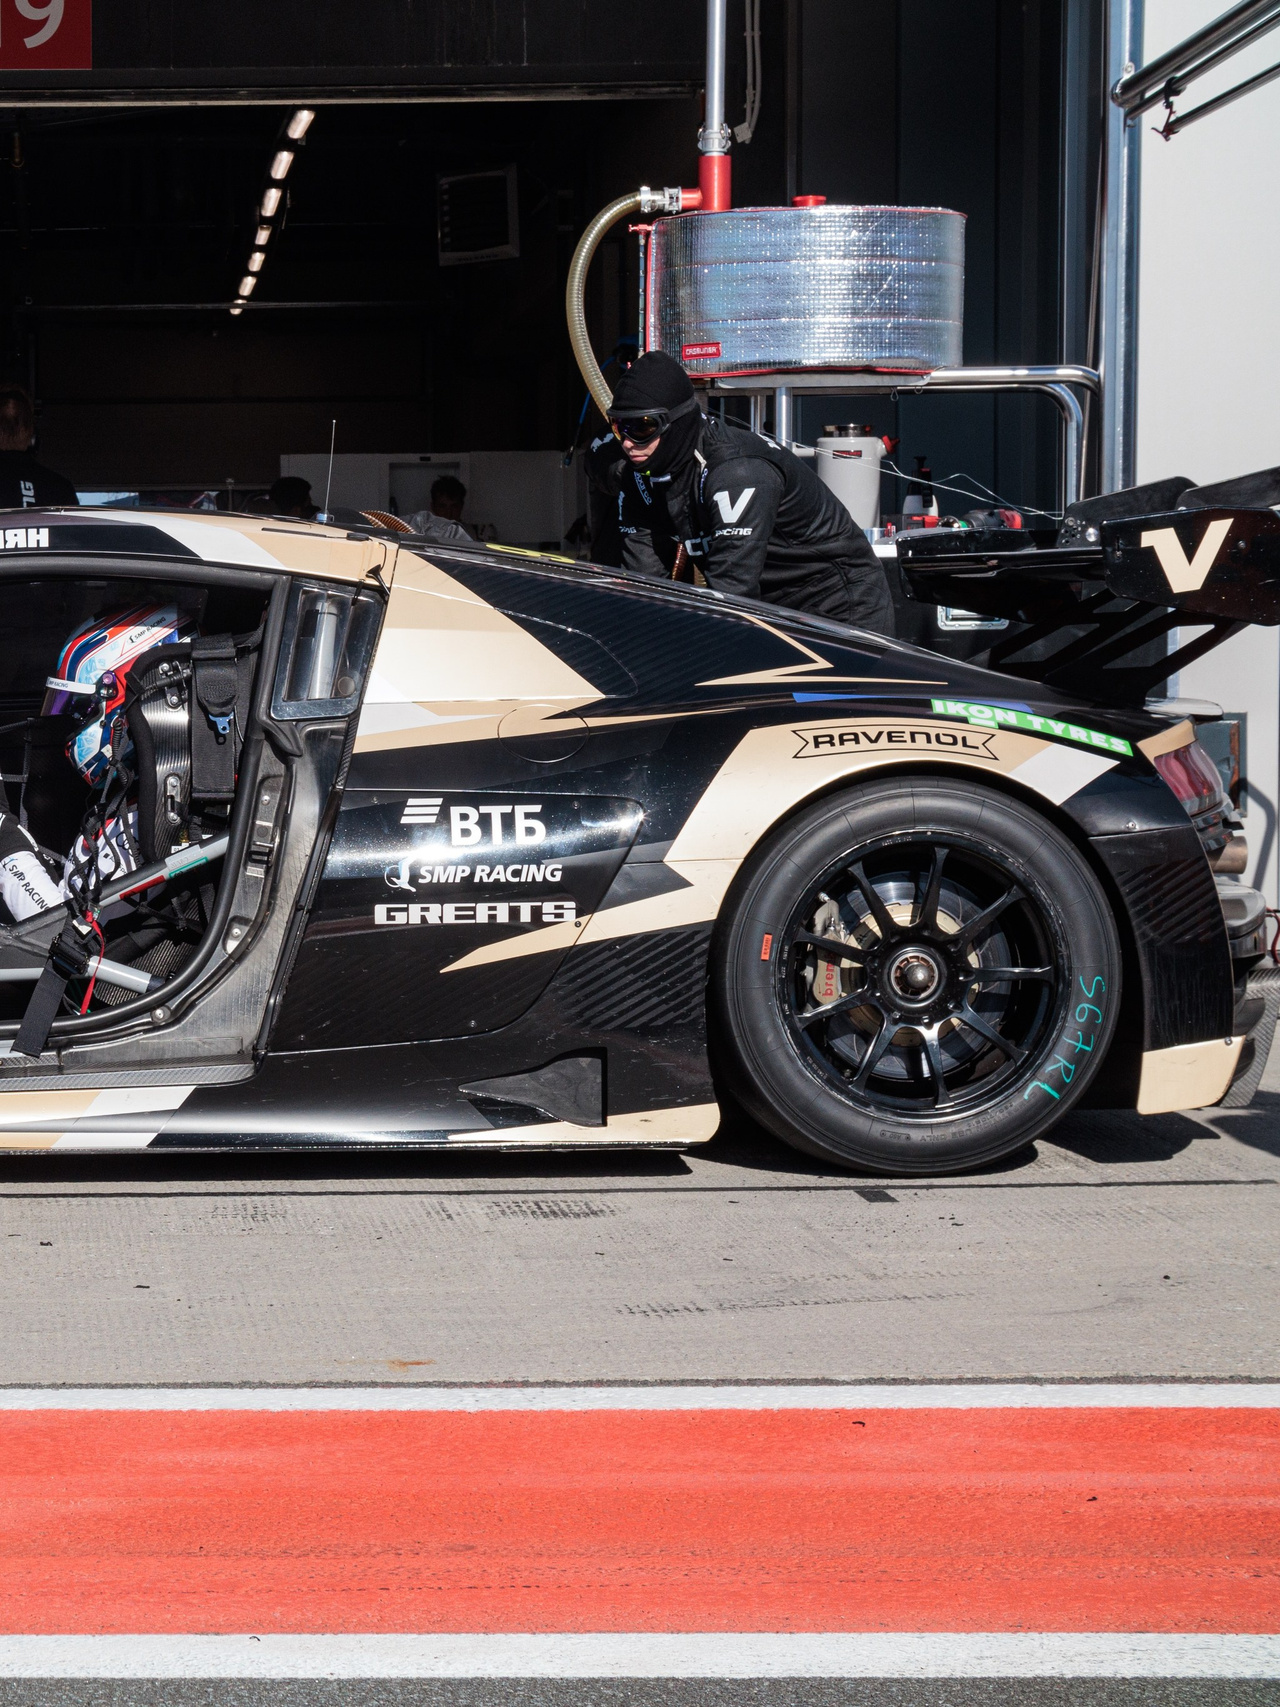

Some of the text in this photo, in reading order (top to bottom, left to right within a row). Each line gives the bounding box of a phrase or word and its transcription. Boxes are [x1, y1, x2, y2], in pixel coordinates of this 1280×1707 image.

[934, 699, 1129, 753] IKON TYRES
[812, 729, 980, 750] RAVENOL
[449, 804, 547, 846] ВТБ
[8, 864, 25, 882] SMP
[418, 864, 563, 883] SMP RACING
[374, 901, 577, 925] GREATS
